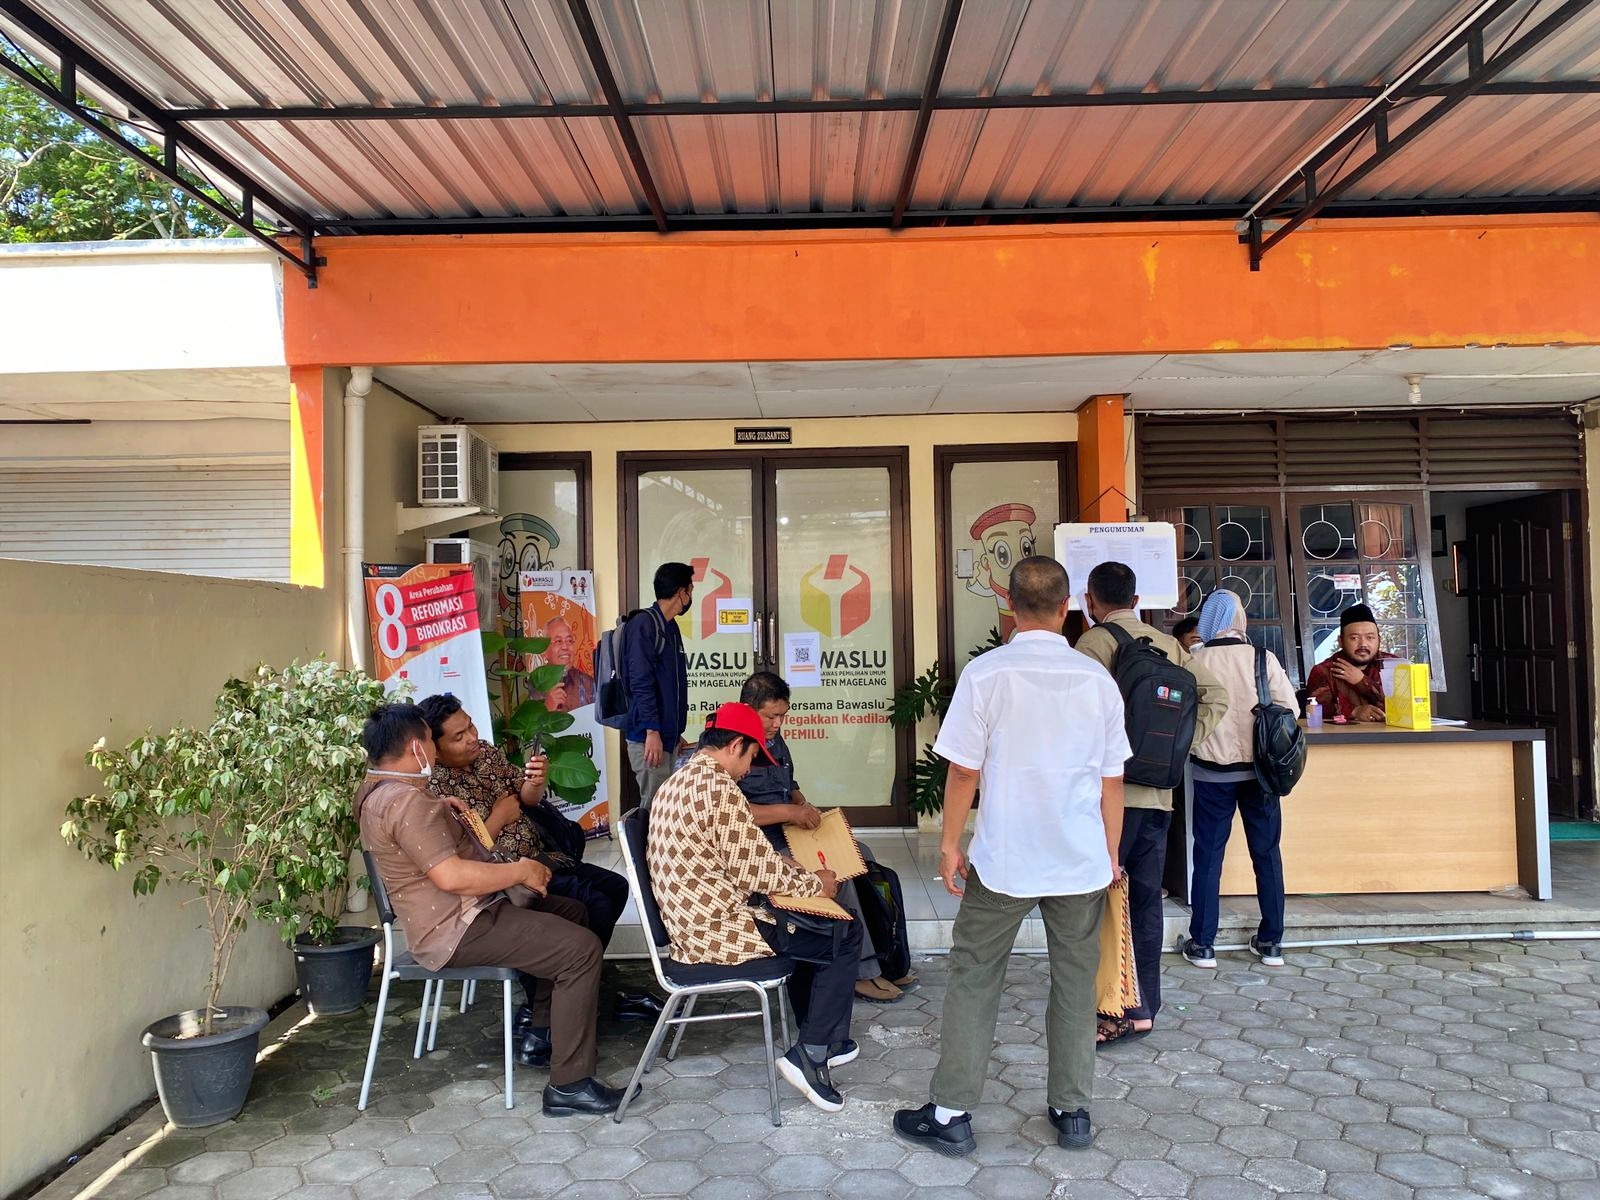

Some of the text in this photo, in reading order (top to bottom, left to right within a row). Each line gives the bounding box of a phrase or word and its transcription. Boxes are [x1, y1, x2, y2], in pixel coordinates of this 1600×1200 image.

[737, 431, 756, 440] RUANG
[1089, 526, 1145, 534] PENGUMUMAN
[409, 583, 454, 600] Area Perubahan
[411, 597, 464, 621] REFORMASI
[375, 583, 408, 659] 8
[416, 615, 467, 641] BIROKRASI
[685, 652, 747, 670] WASLU
[820, 650, 887, 669] WASLU
[839, 678, 887, 686] MAGELANG
[837, 699, 885, 710] Bawaslu
[784, 713, 838, 726] Tegakkan
[784, 728, 829, 740] PEMILU.
